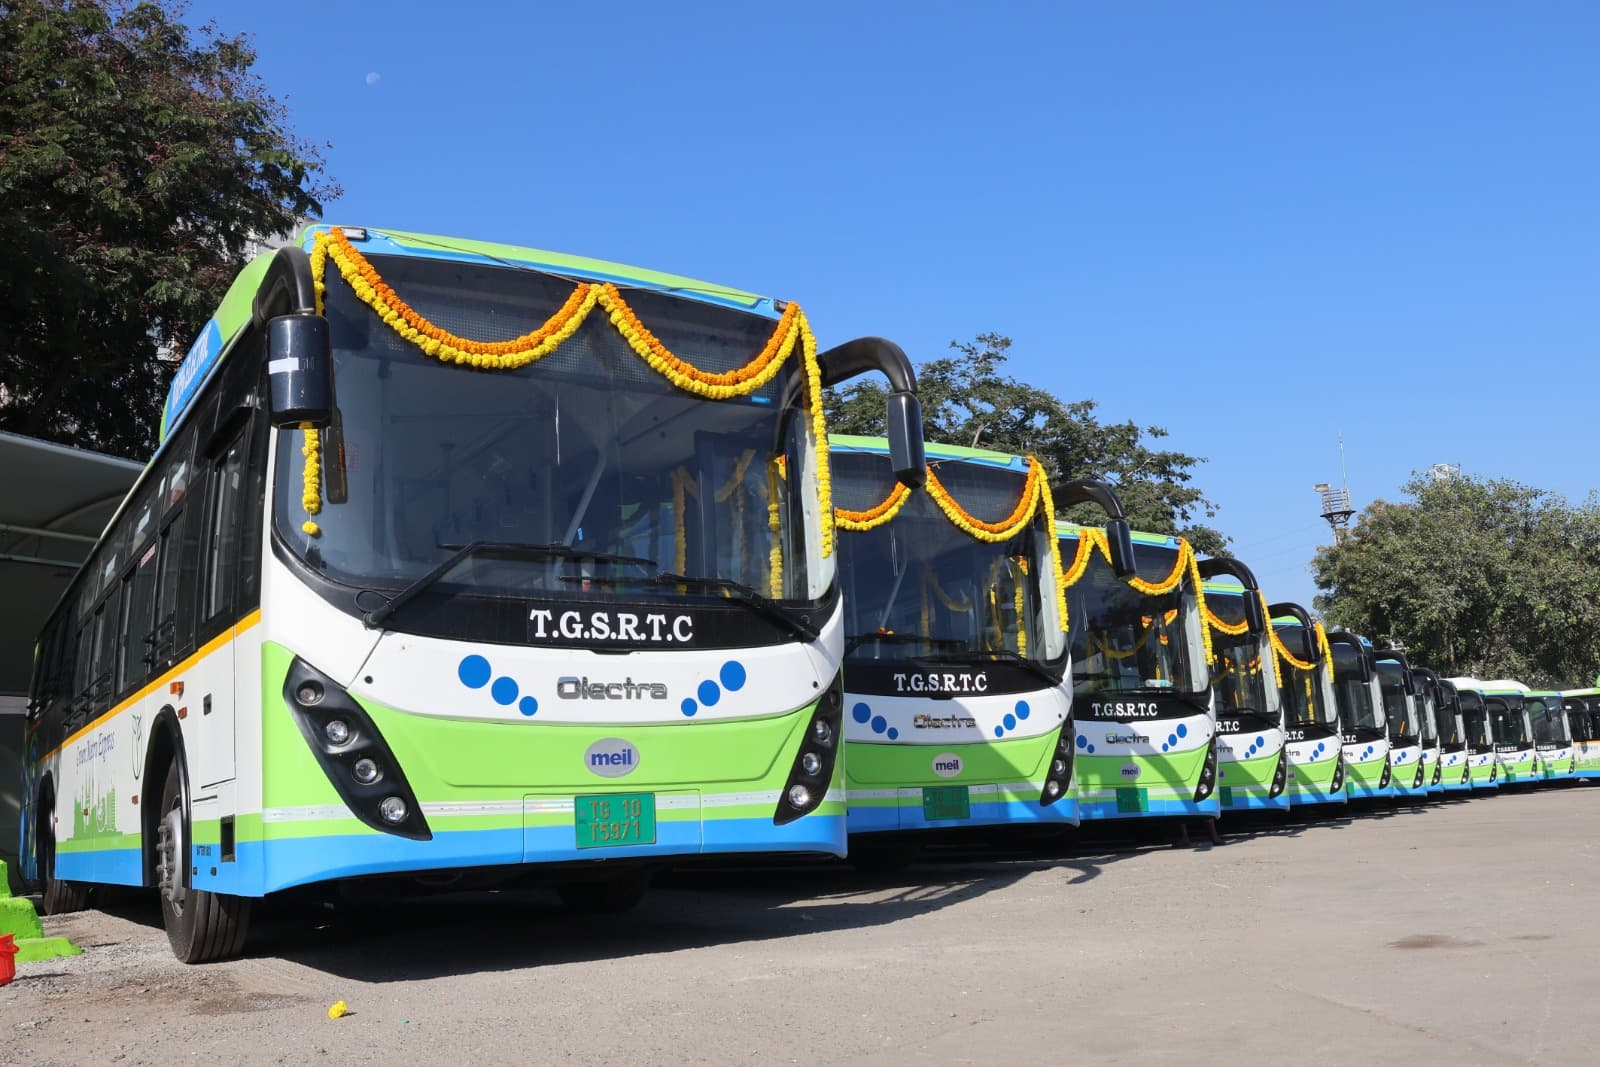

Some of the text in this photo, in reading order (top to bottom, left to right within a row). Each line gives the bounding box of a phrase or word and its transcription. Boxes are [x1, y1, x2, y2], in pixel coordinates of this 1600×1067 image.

[529, 608, 693, 642] T.G.S.R.T.C
[557, 676, 668, 700] Olectra
[893, 673, 988, 692] T.G.S.R.T.C
[1091, 703, 1158, 717] T.G.S.R.T.C
[913, 714, 977, 729] Olectra
[1105, 732, 1150, 744] Olectra
[591, 748, 632, 766] meil
[935, 759, 959, 771] meil
[590, 799, 641, 819] TG 10
[590, 820, 641, 842] T5971
